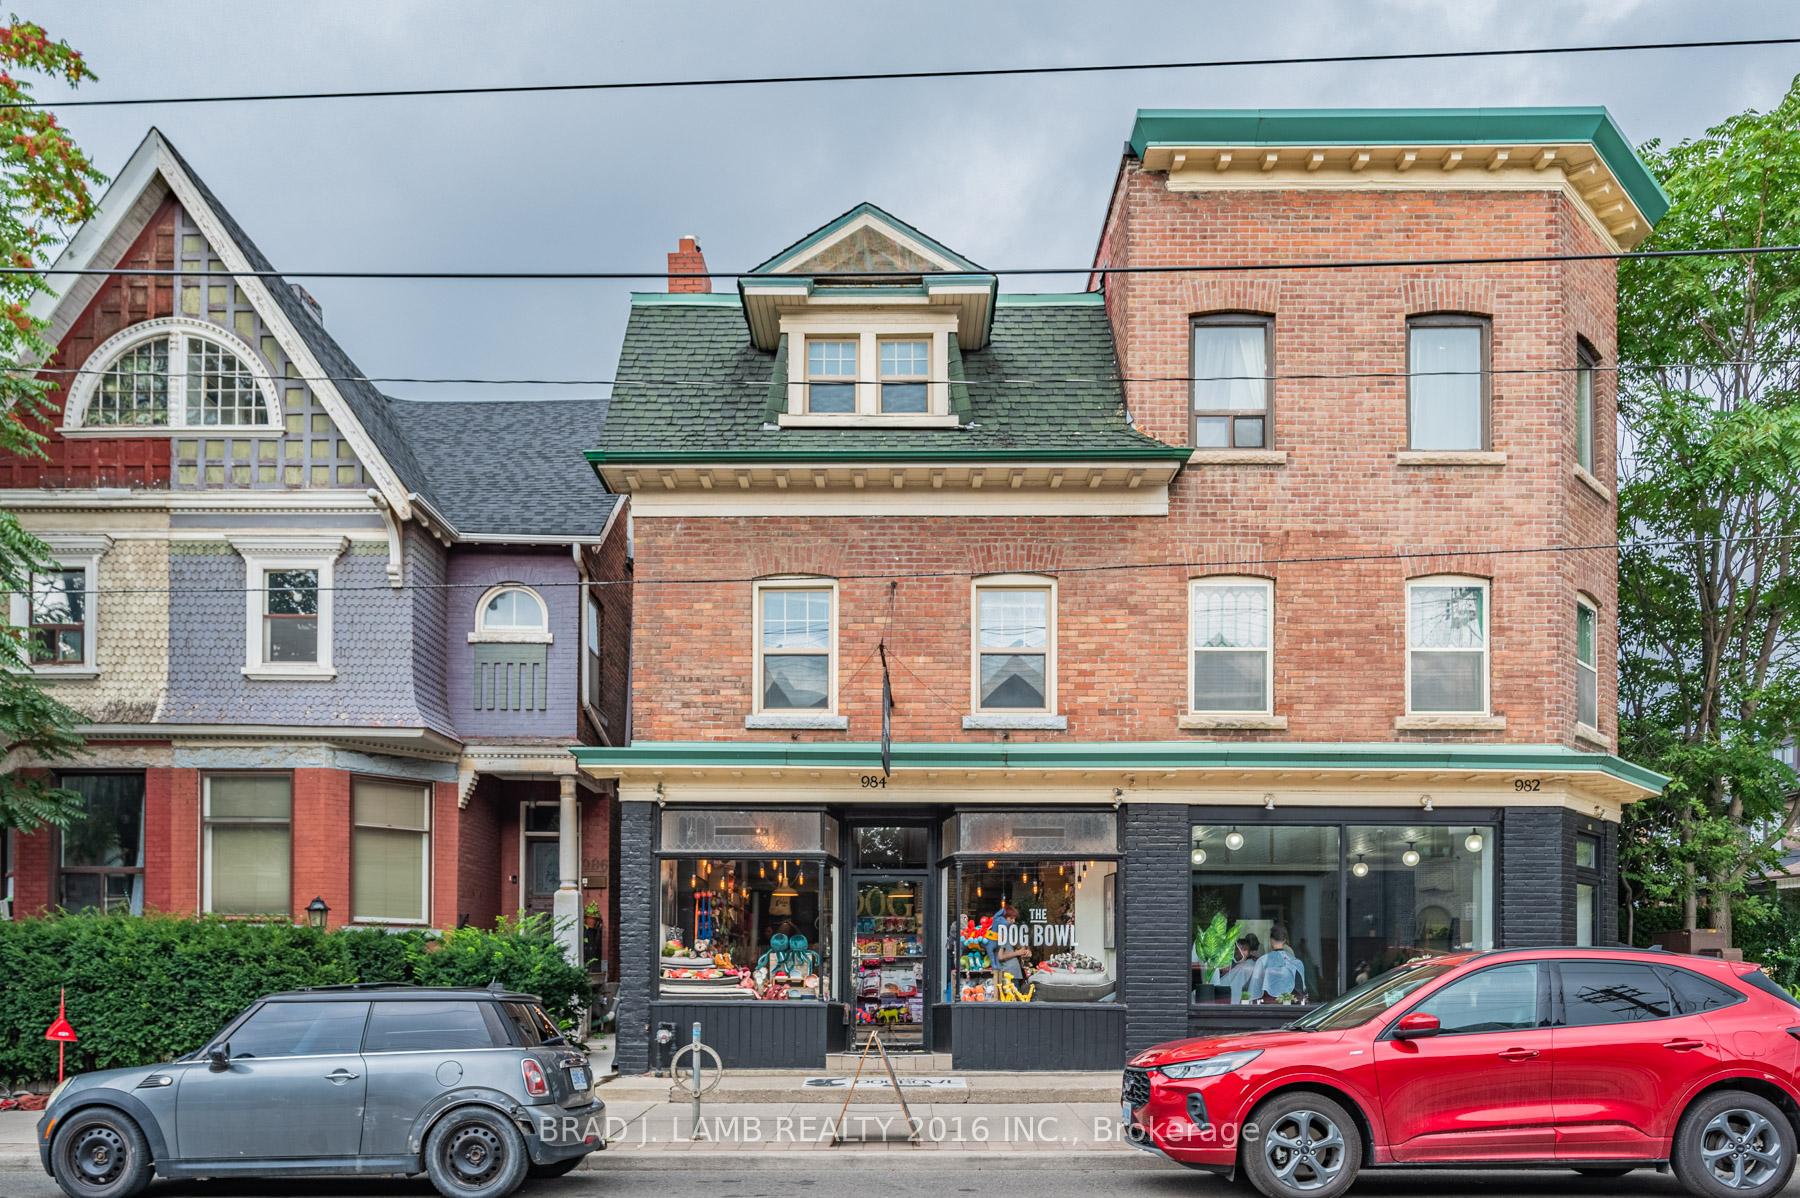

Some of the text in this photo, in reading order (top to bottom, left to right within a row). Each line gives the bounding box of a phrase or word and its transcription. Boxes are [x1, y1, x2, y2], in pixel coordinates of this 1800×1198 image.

[861, 775, 887, 788] 984
[1514, 779, 1541, 792] 982
[1029, 908, 1047, 920] THE
[998, 924, 1079, 947] DOG BOWL
